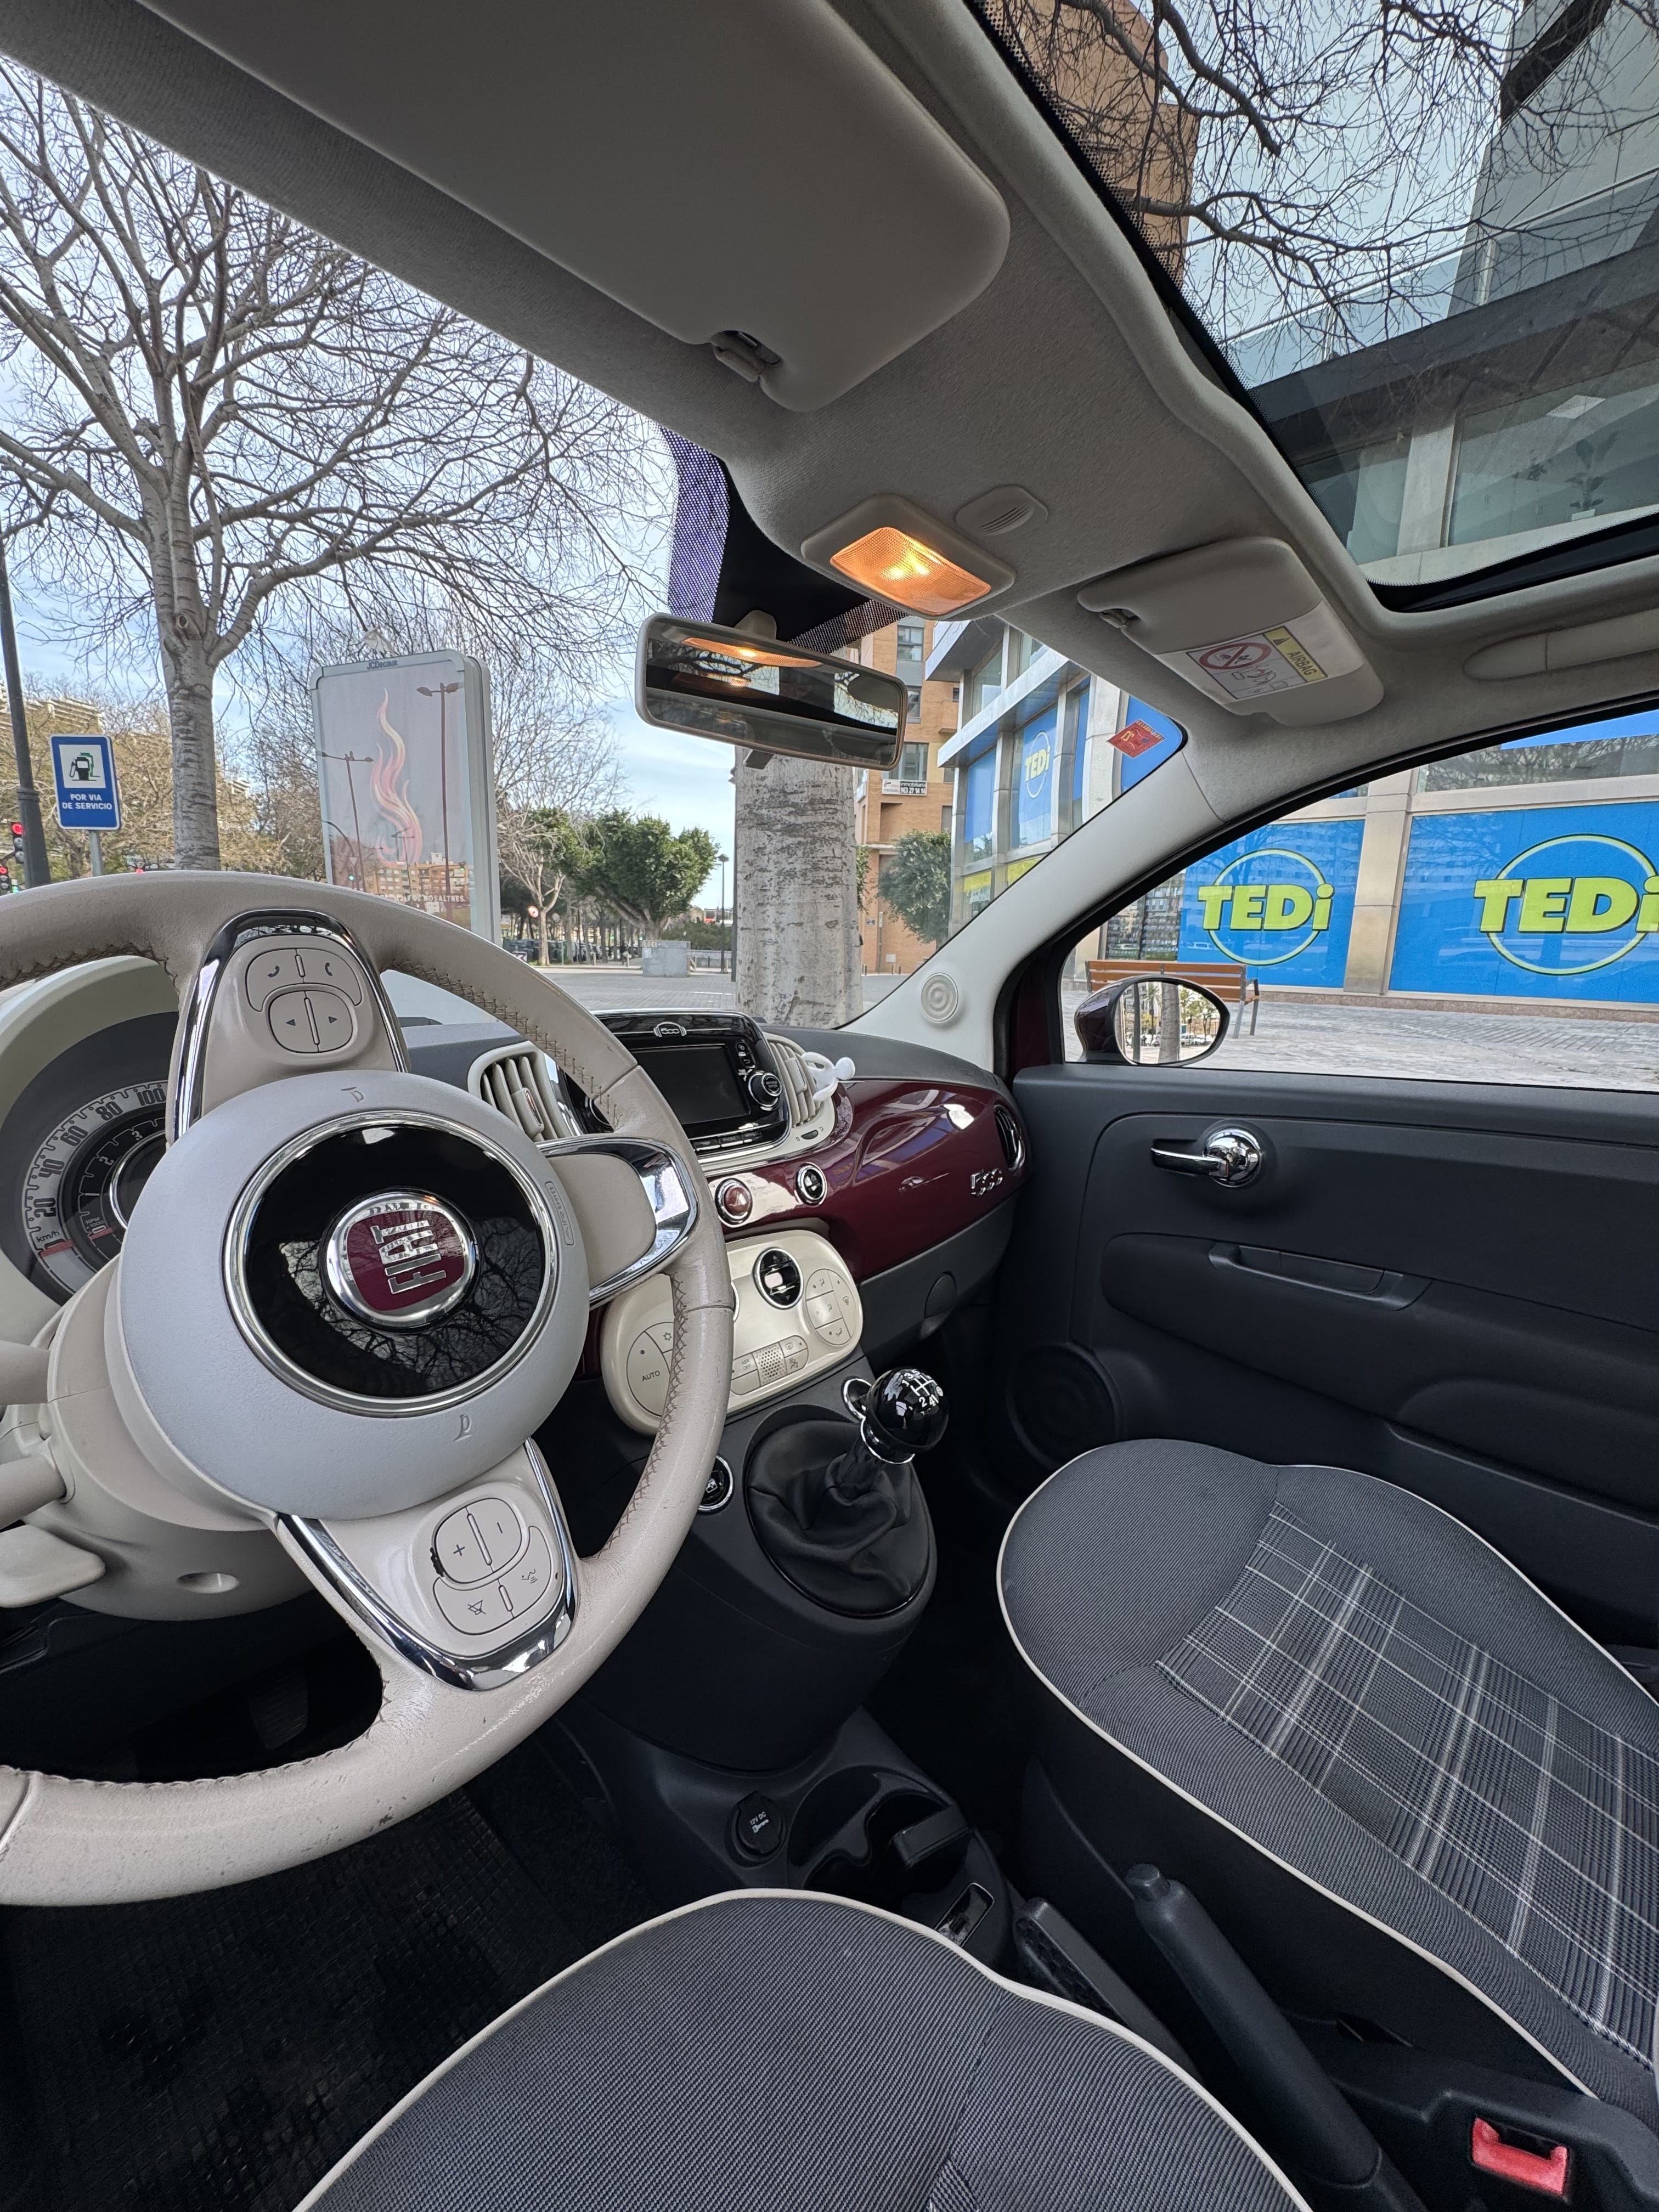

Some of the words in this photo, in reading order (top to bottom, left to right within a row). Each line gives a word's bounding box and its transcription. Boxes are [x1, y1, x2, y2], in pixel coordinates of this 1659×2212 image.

[1286, 651, 1317, 675] AIRBAG
[1025, 746, 1051, 783] TEDi
[1198, 883, 1335, 932] TEDi
[1474, 875, 1659, 934] TEDi
[137, 1087, 167, 1106] 100
[95, 1102, 123, 1120] 80
[60, 1126, 88, 1146] 60
[38, 1159, 65, 1178] 40
[99, 1156, 114, 1166] 2
[33, 1198, 56, 1218] 20
[36, 1231, 60, 1242] km/h
[370, 1220, 447, 1295] FIAT
[641, 1370, 661, 1381] AUTO
[919, 1397, 928, 1408] 2
[758, 1811, 766, 1820] DC
